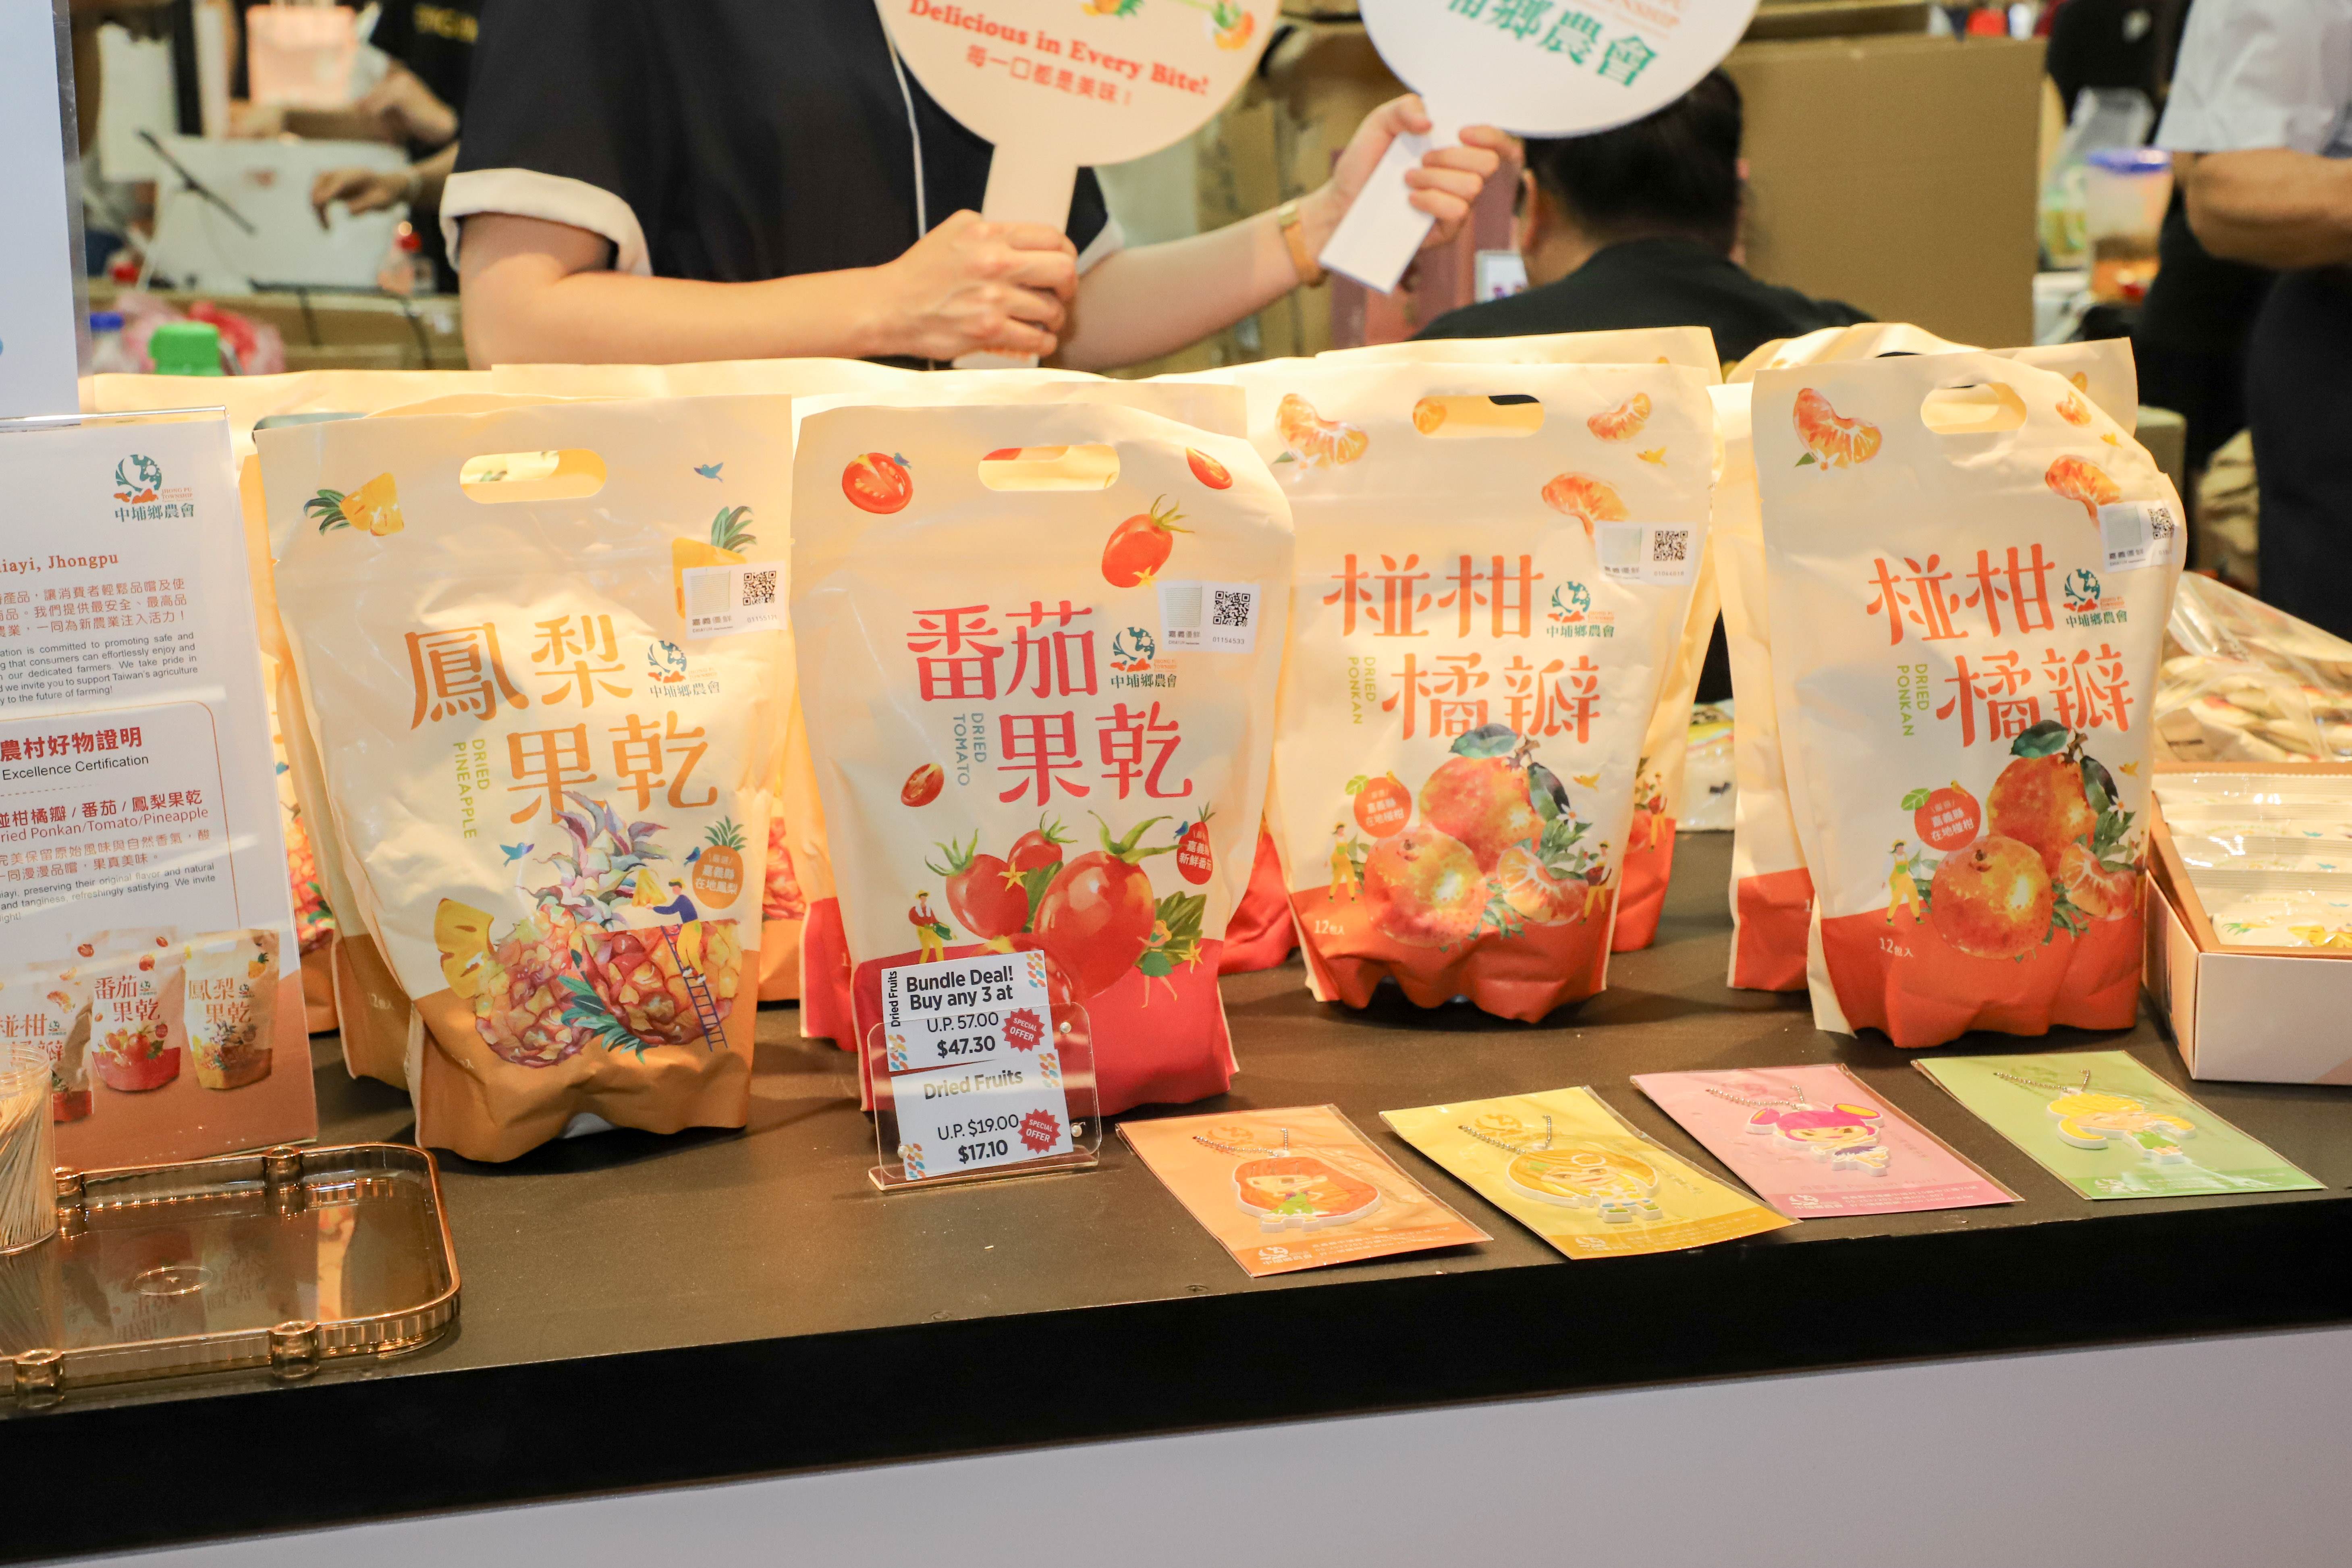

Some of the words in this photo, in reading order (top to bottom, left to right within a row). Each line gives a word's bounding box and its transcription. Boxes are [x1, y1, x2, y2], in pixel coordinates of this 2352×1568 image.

[908, 0, 1029, 48] Delicious
[1036, 29, 1063, 56] in
[1069, 39, 1144, 81] Every
[1150, 59, 1210, 97] Bite!
[114, 503, 194, 523] 中埔鄉農會
[0, 557, 41, 574] iayi,
[48, 554, 119, 569] Jhongpu
[1322, 553, 1545, 639] 椪柑
[1866, 543, 2055, 646] 椪柑
[1547, 625, 1615, 638] 中埔鄉農會
[2066, 610, 2128, 628] 中埔鄉農會
[9, 659, 26, 669] that
[29, 655, 79, 666] consumers
[82, 653, 99, 661] can
[102, 647, 149, 660] effortlessly
[152, 644, 176, 656] enjoy
[179, 643, 195, 652] and
[27, 646, 35, 654] is
[39, 642, 86, 654] committed
[105, 636, 149, 648] promoting
[154, 634, 172, 642] safe
[177, 632, 194, 641] and
[906, 600, 1098, 702] 番茄
[8, 672, 23, 680] our
[28, 667, 73, 678] dedicated
[118, 660, 134, 669] We
[139, 658, 158, 667] take
[162, 656, 184, 666] pride
[189, 654, 197, 663] in
[21, 681, 45, 691] invite
[47, 681, 64, 690] you
[66, 678, 75, 686] to
[77, 674, 110, 686] support
[112, 670, 151, 682] Taiwan's
[153, 666, 198, 679] agriculture
[404, 613, 633, 731] 鳳梨
[1364, 656, 1376, 702] DRIED
[7, 695, 17, 704] to
[19, 693, 33, 702] the
[36, 690, 63, 701] future
[65, 689, 74, 698] of
[76, 685, 113, 698] farming!
[650, 680, 720, 698] 中埔鄉農會
[1111, 673, 1177, 689] 中埔鄉農會
[1348, 656, 1363, 724] PONKAN
[1915, 664, 1930, 711] DRIED
[1382, 652, 1601, 745] 橘瓣
[1897, 665, 1915, 736] PONKAN
[1935, 643, 2134, 748] 橘瓣
[0, 727, 143, 762] 農村好物證明
[953, 713, 970, 786] TOMATO
[971, 712, 987, 763] DRIED
[472, 738, 490, 790] DRIED
[506, 709, 718, 824] 果乾
[997, 701, 1193, 807] 果乾
[2, 764, 72, 781] Excellence
[75, 755, 149, 773] Certification
[81, 800, 117, 818] 番茄
[132, 789, 202, 812] 鳳梨果乾
[453, 741, 478, 839] PINEAPPLE
[31, 807, 209, 839] Ponkan/Tomato/Pineapple
[1, 901, 18, 911] and
[72, 886, 124, 901] refreshingly
[175, 876, 190, 887] We
[193, 874, 216, 885] invite
[24, 883, 72, 897] preserving
[75, 879, 95, 889] their
[99, 874, 132, 887] original
[135, 870, 161, 881] flavor
[164, 867, 181, 877] and
[184, 862, 214, 874] natural
[94, 975, 138, 1001] 番茄
[188, 977, 235, 1001] 鳳梨
[888, 970, 898, 998] Fruits
[906, 972, 966, 993] Bundle
[970, 966, 1013, 986] Deal!
[112, 998, 161, 1024] 果乾
[910, 993, 942, 1011] Buy
[947, 991, 977, 1007] any
[982, 986, 992, 1002] 3
[996, 984, 1013, 1001] at
[205, 1001, 253, 1024] 果乾
[889, 1001, 901, 1027] Dried
[927, 1017, 954, 1033] U.P.
[957, 1012, 999, 1030] 57.00
[1013, 1018, 1037, 1032] SPECIAL
[937, 1035, 995, 1059] $47.30
[1009, 1026, 1034, 1043] OFFER
[924, 1076, 971, 1100] Dried
[974, 1070, 1023, 1091] Fruits
[938, 1123, 965, 1140] U.P.
[967, 1114, 1019, 1137] $19.00
[1026, 1128, 1050, 1143] OFFER
[1029, 1119, 1052, 1132] SPECIAL
[958, 1140, 1008, 1164] $17.10
